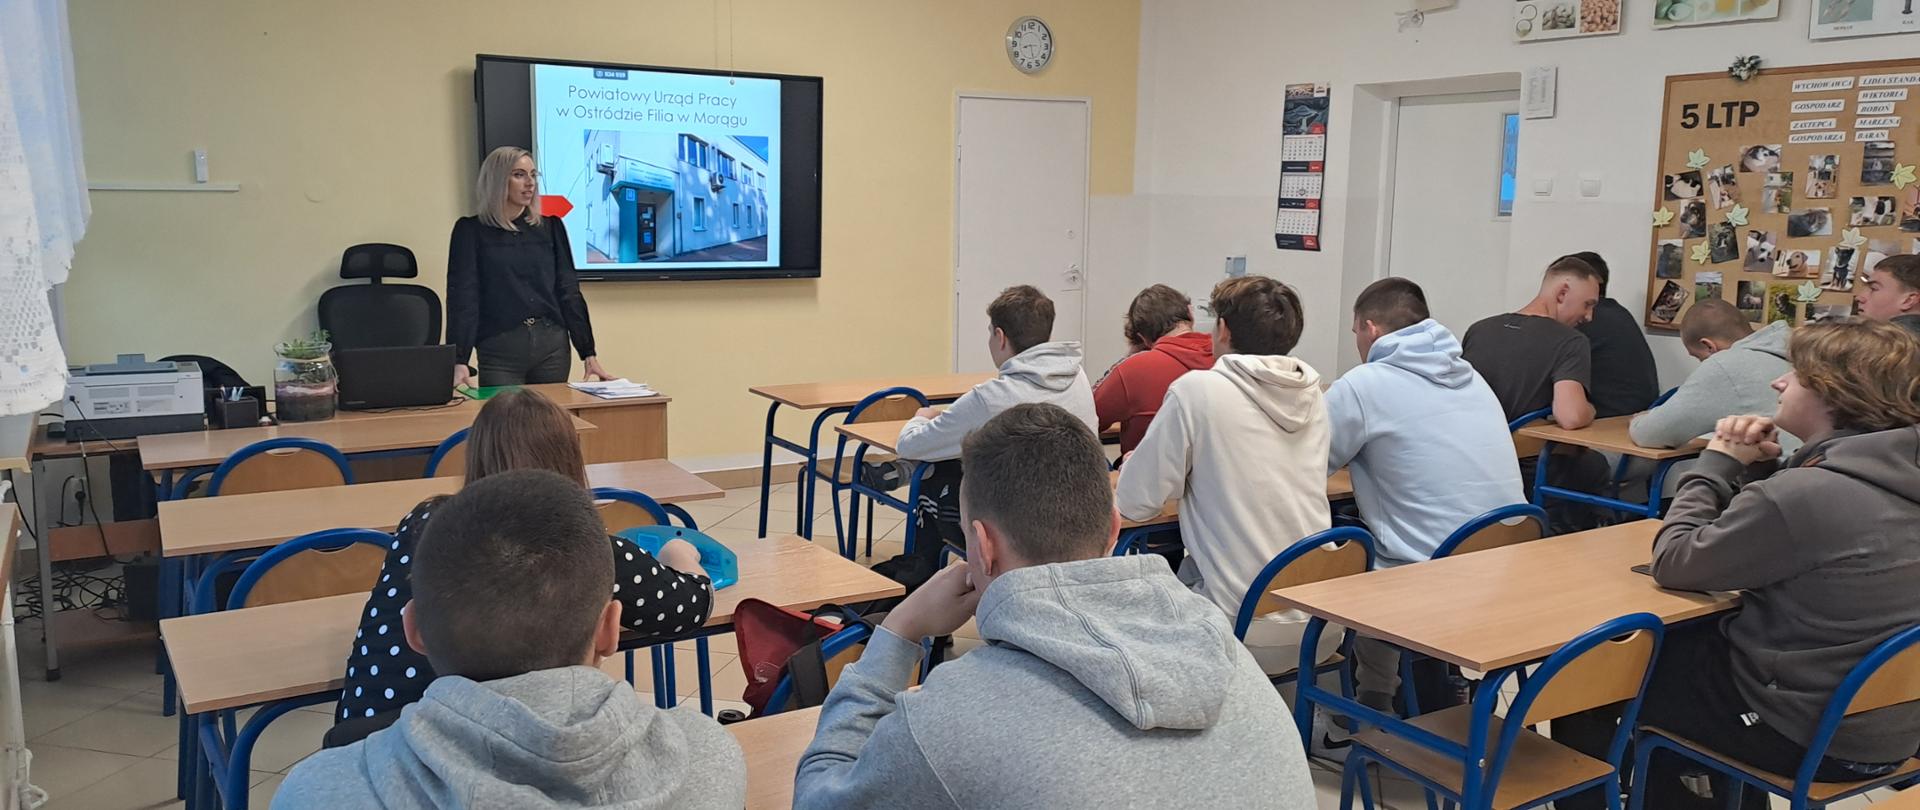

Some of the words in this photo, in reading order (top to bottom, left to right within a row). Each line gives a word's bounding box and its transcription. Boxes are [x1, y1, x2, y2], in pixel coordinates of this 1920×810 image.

[568, 84, 651, 105] Powiatowy
[654, 90, 693, 107] Urząd
[698, 92, 737, 109] Pracy
[1794, 101, 1842, 110] GOSPODARZ
[556, 107, 570, 117] w
[573, 104, 643, 121] Ostródzie
[647, 108, 674, 122] Filia
[677, 113, 690, 123] w
[693, 111, 748, 128] Morągu
[1680, 103, 1700, 130] 5
[1706, 101, 1760, 129] LTP
